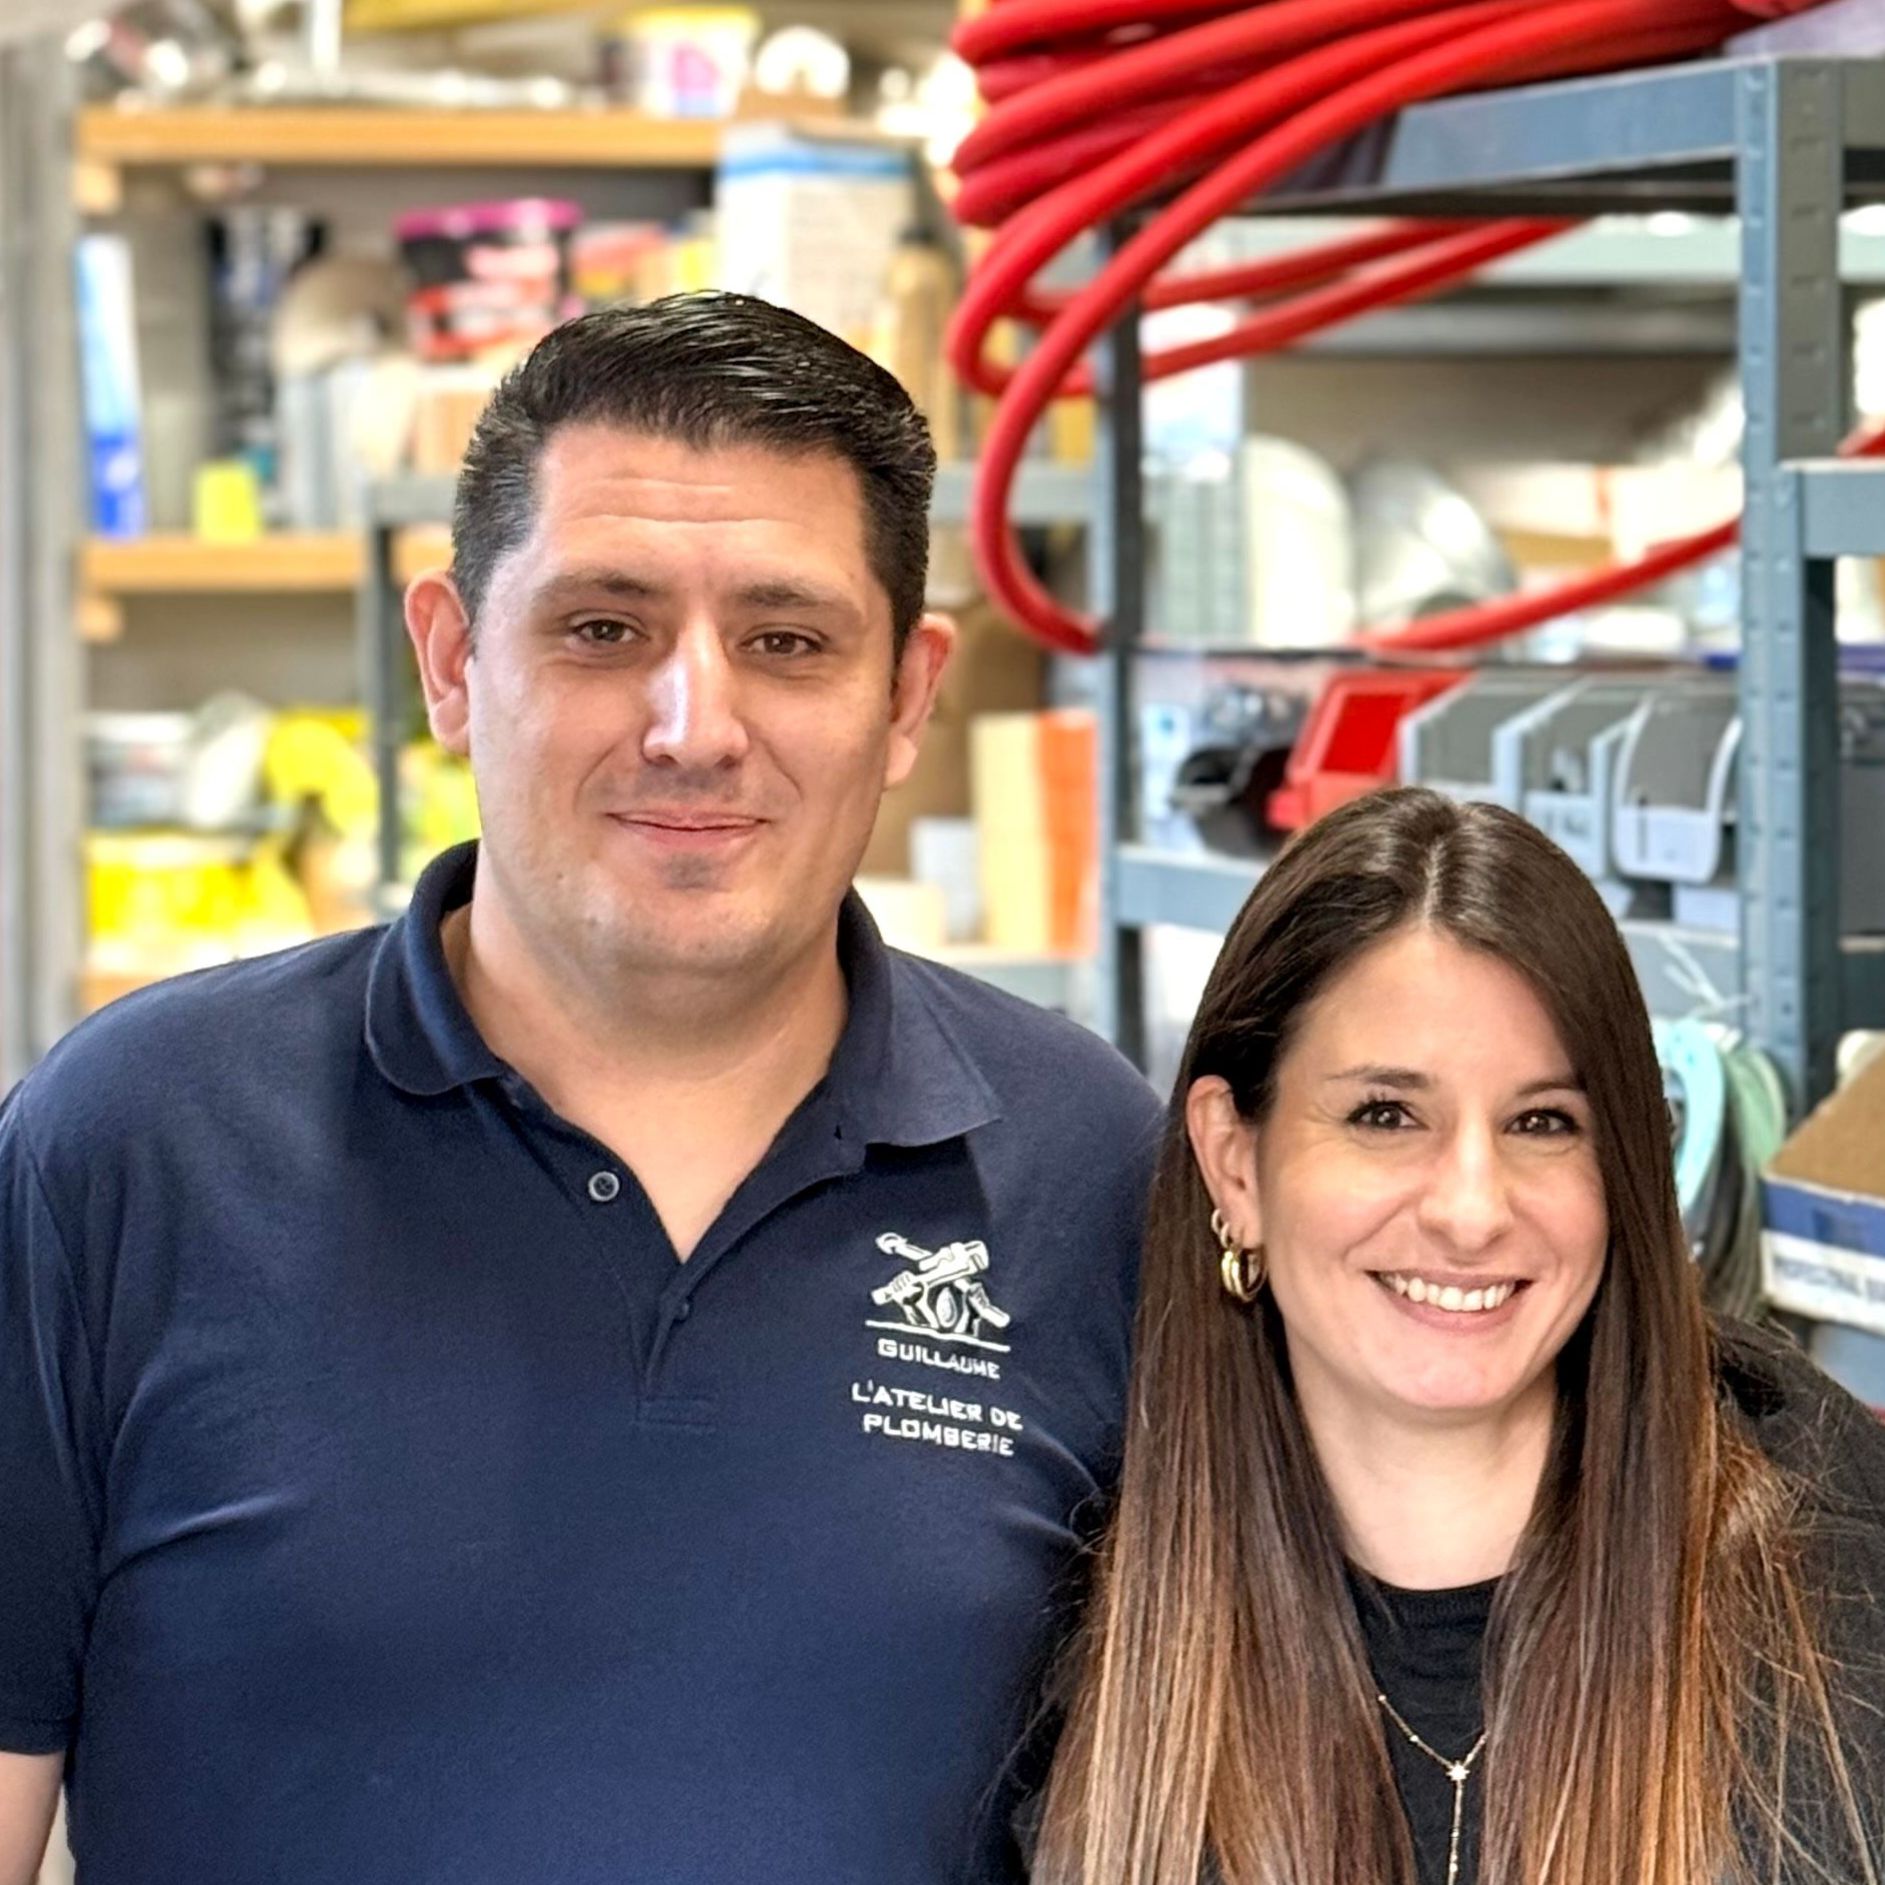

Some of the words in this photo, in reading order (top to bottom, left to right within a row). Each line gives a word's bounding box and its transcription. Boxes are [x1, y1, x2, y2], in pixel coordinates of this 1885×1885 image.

[878, 1339, 1000, 1379] GUILLAUME
[852, 1379, 983, 1422] L'ATELIER
[990, 1406, 1023, 1430] DE
[863, 1413, 1014, 1456] PLOMBERIE
